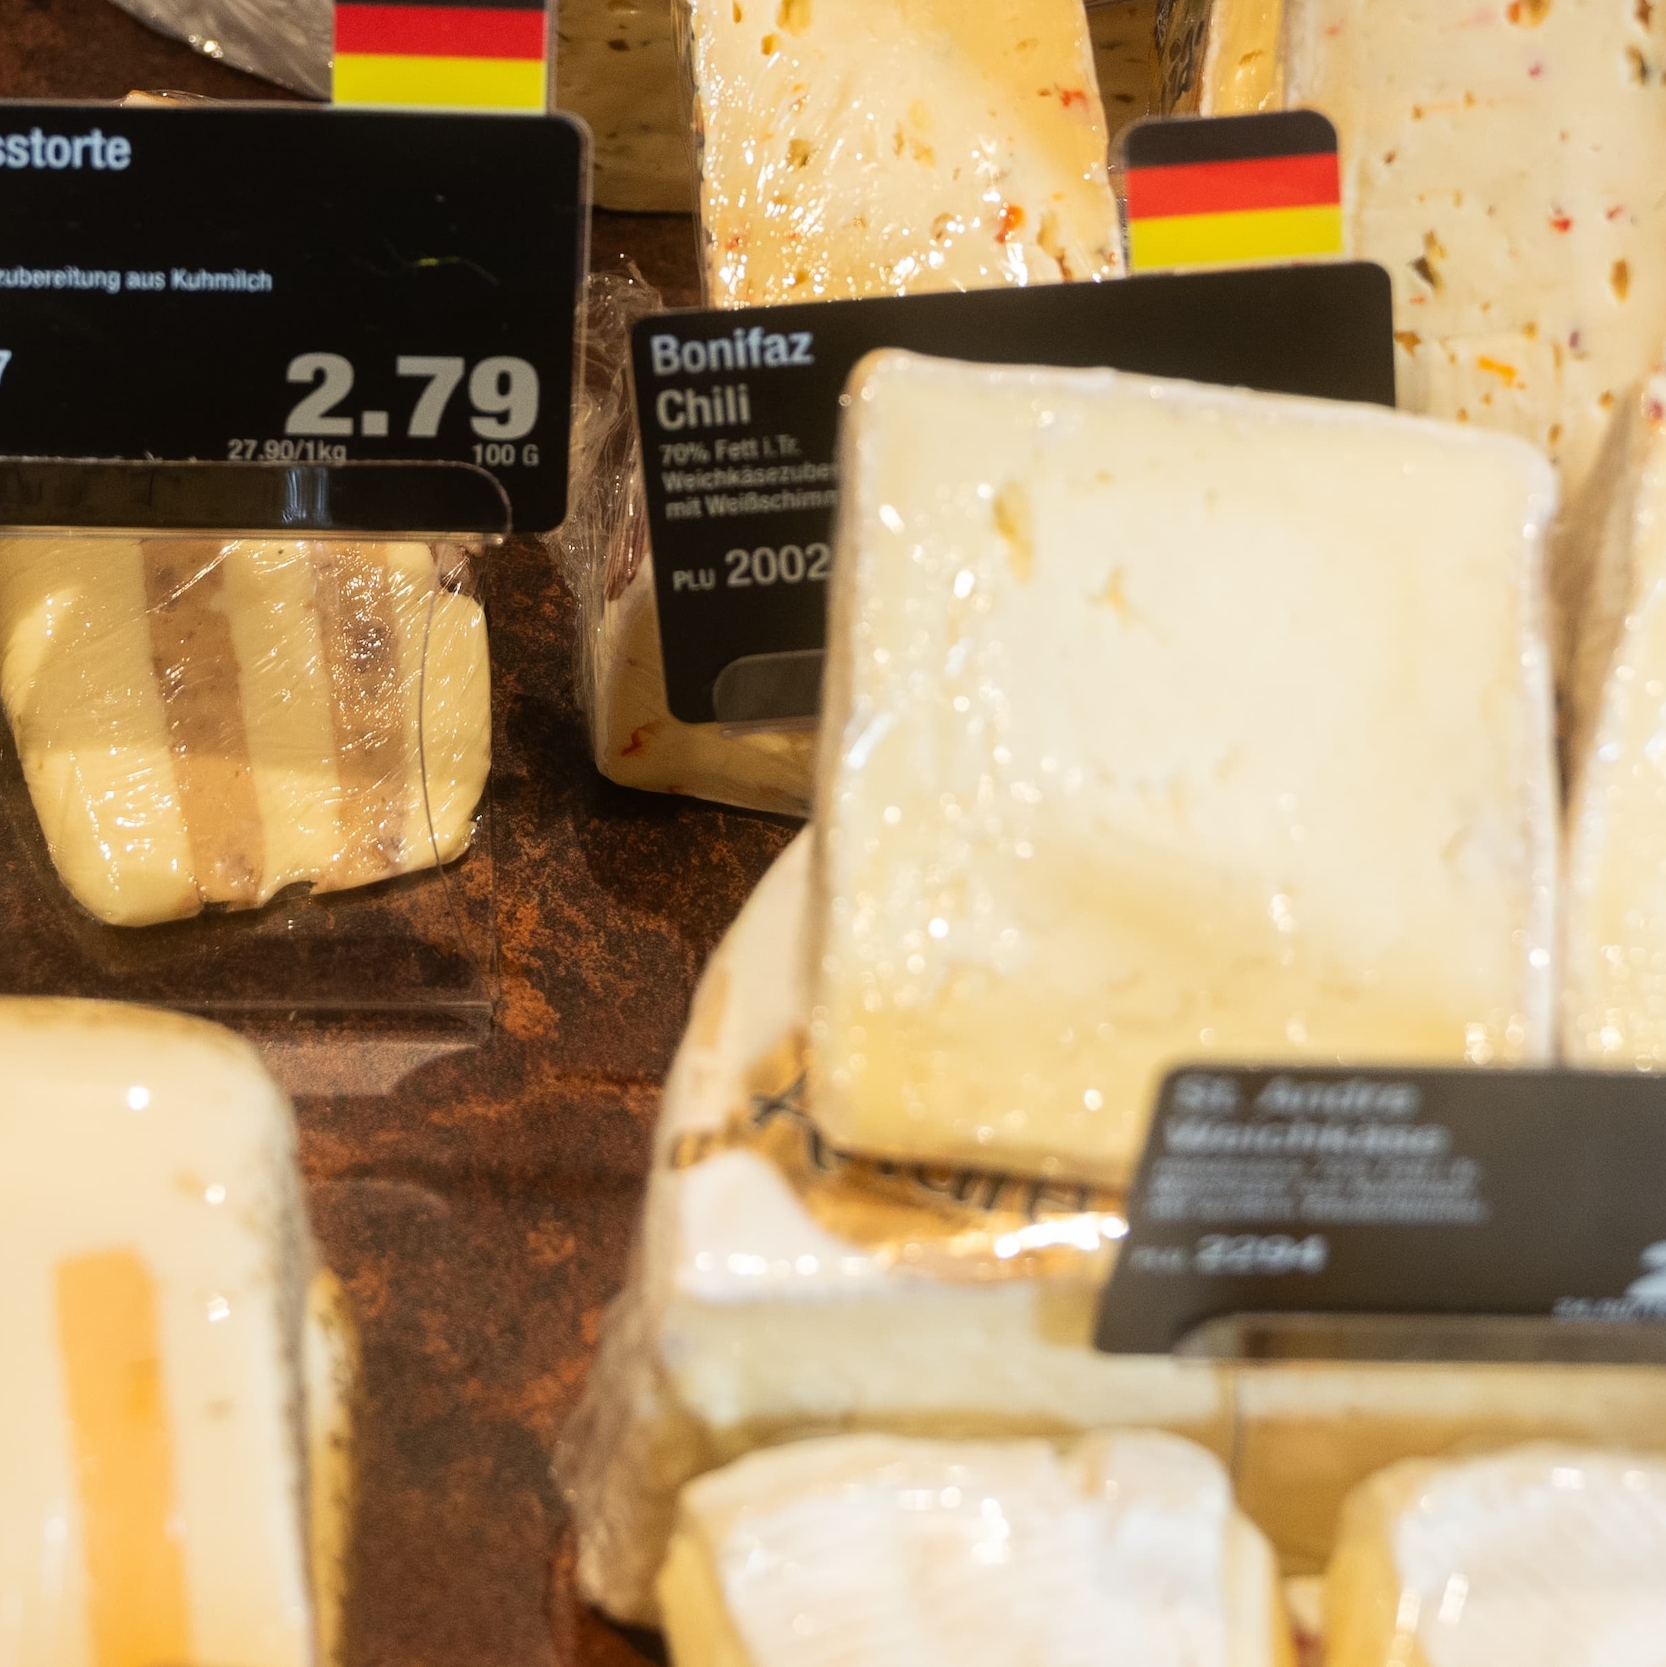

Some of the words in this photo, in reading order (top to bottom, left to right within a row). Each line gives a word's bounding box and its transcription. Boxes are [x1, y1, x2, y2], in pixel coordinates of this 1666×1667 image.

[125, 271, 166, 290] aus
[170, 268, 273, 292] Kuhmilch
[651, 326, 813, 375] Bonifaz
[284, 352, 540, 441] 2.79
[656, 383, 751, 430] Chili
[223, 438, 353, 465] 27.90/1kg
[468, 443, 516, 467] 100
[522, 443, 539, 466] G
[661, 442, 711, 465] 70%
[714, 438, 759, 461] Fett
[762, 434, 799, 456] i.Tr.
[673, 570, 715, 590] PLU
[725, 542, 831, 588] 2002
